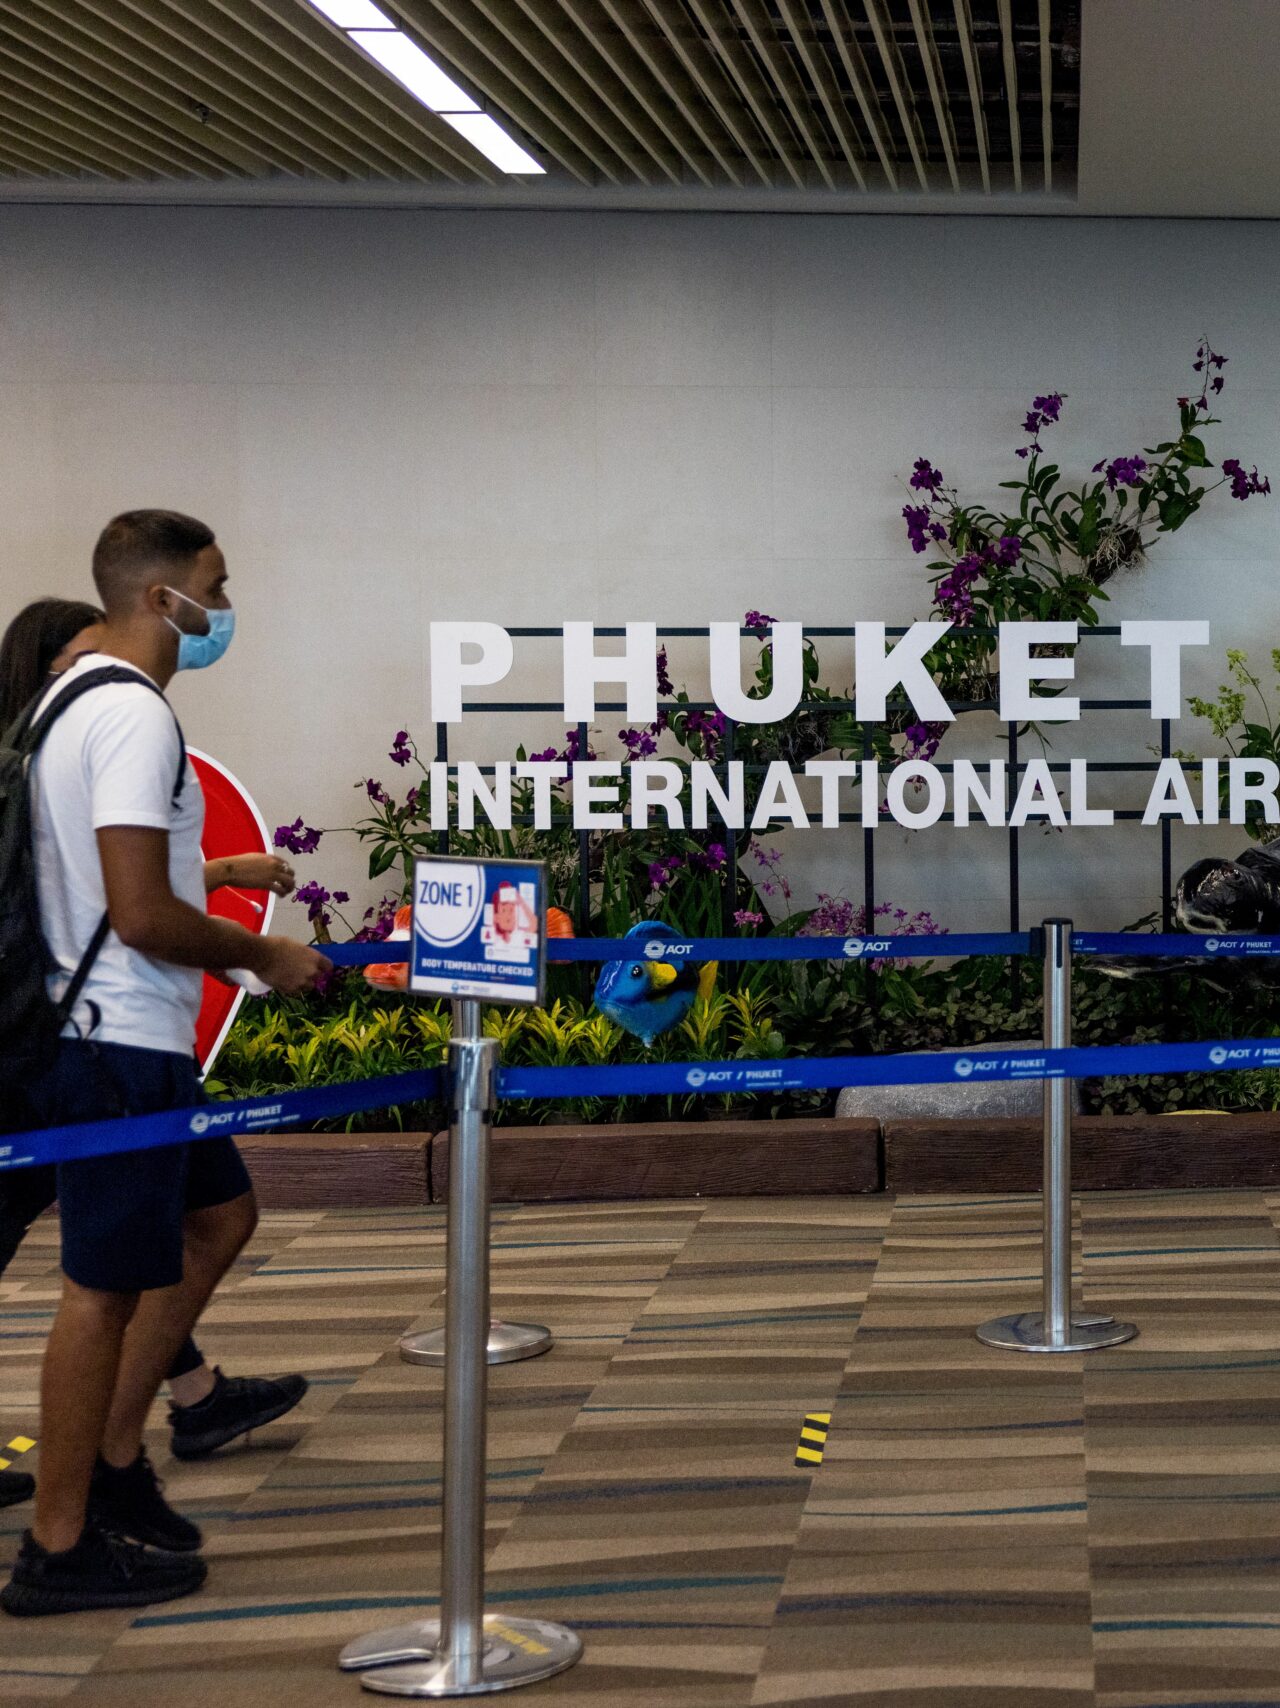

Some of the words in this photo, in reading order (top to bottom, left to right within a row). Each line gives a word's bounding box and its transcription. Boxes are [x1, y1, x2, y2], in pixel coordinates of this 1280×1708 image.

[429, 620, 1210, 724] PHUKET
[430, 758, 1114, 830] INTERNATIONAL
[419, 880, 462, 907] ZONE
[466, 884, 473, 908] 1
[664, 945, 694, 955] AOT
[862, 941, 892, 951] AOT
[421, 957, 442, 968] BODY
[443, 959, 497, 973] TEMPERATURE
[497, 965, 534, 977] CHECKED
[1228, 1049, 1250, 1059] AOT
[974, 1060, 999, 1070] AOT
[1010, 1058, 1047, 1068] PHUKET
[707, 1071, 733, 1081] AOT
[746, 1069, 783, 1080] PHUKET
[209, 1112, 235, 1126] AOT
[246, 1104, 283, 1119] PHUKET
